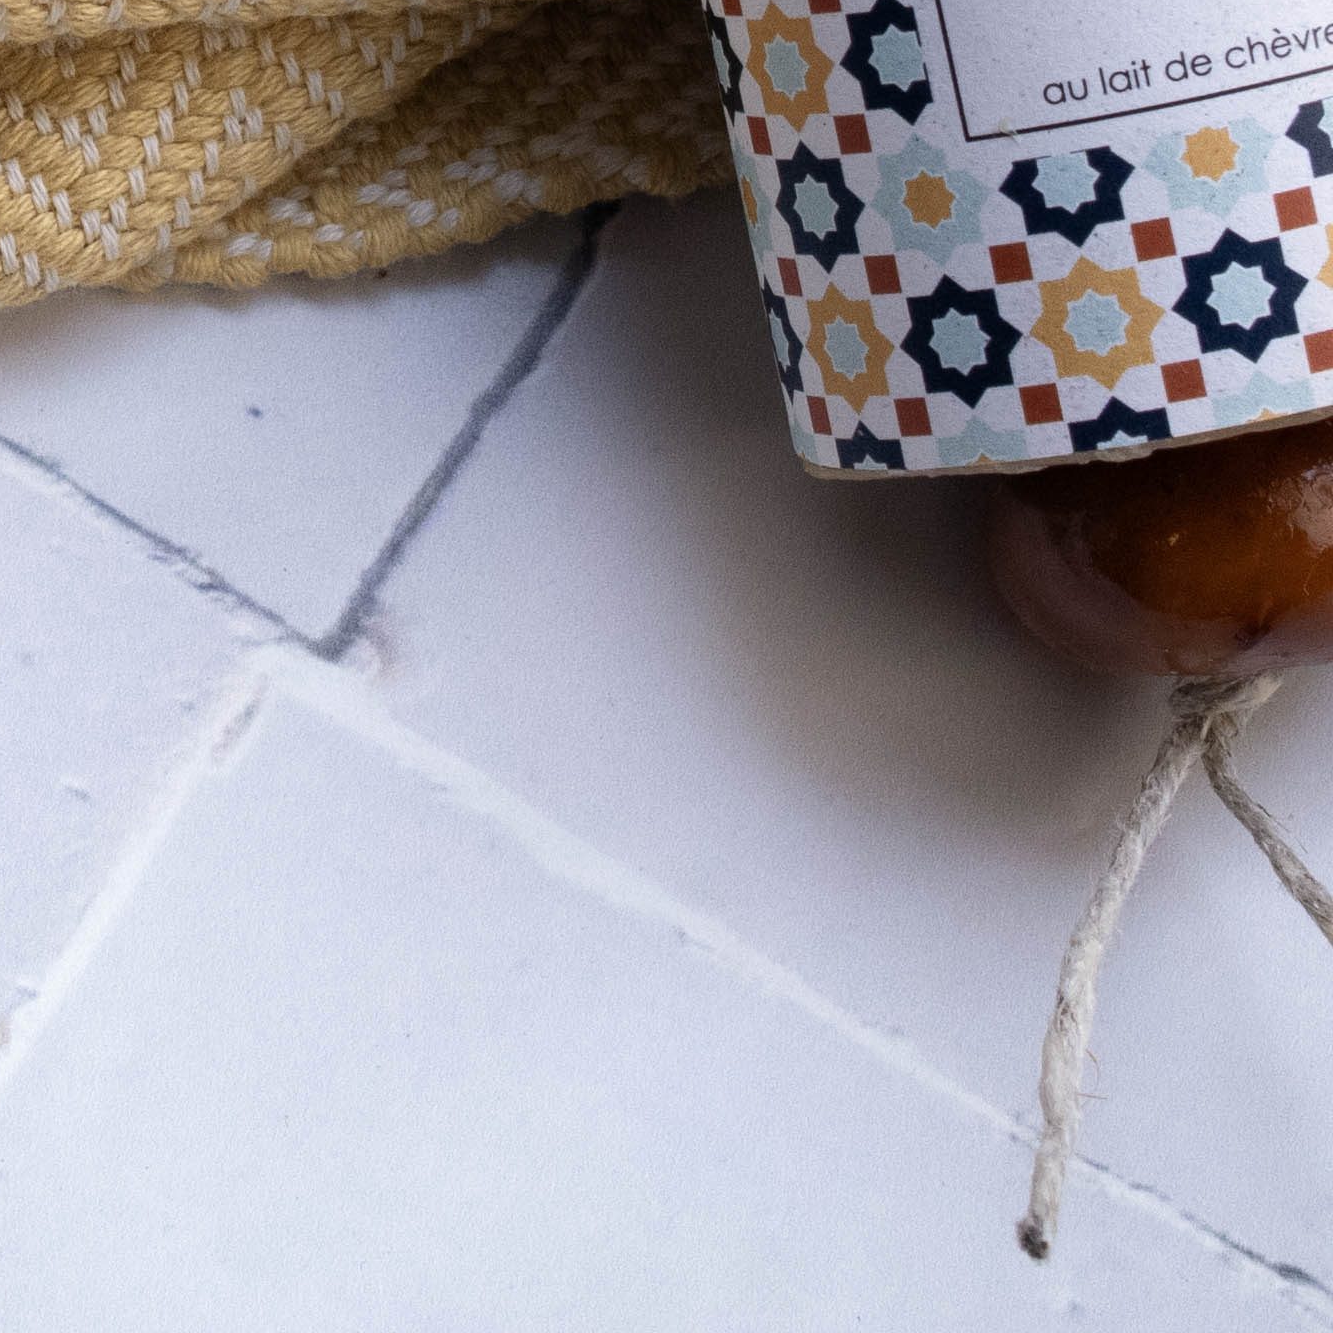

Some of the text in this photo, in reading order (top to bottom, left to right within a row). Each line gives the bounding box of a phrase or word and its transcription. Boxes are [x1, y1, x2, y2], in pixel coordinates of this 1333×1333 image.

[1042, 78, 1089, 106] au
[1098, 59, 1151, 95] lait
[1164, 51, 1212, 82] de
